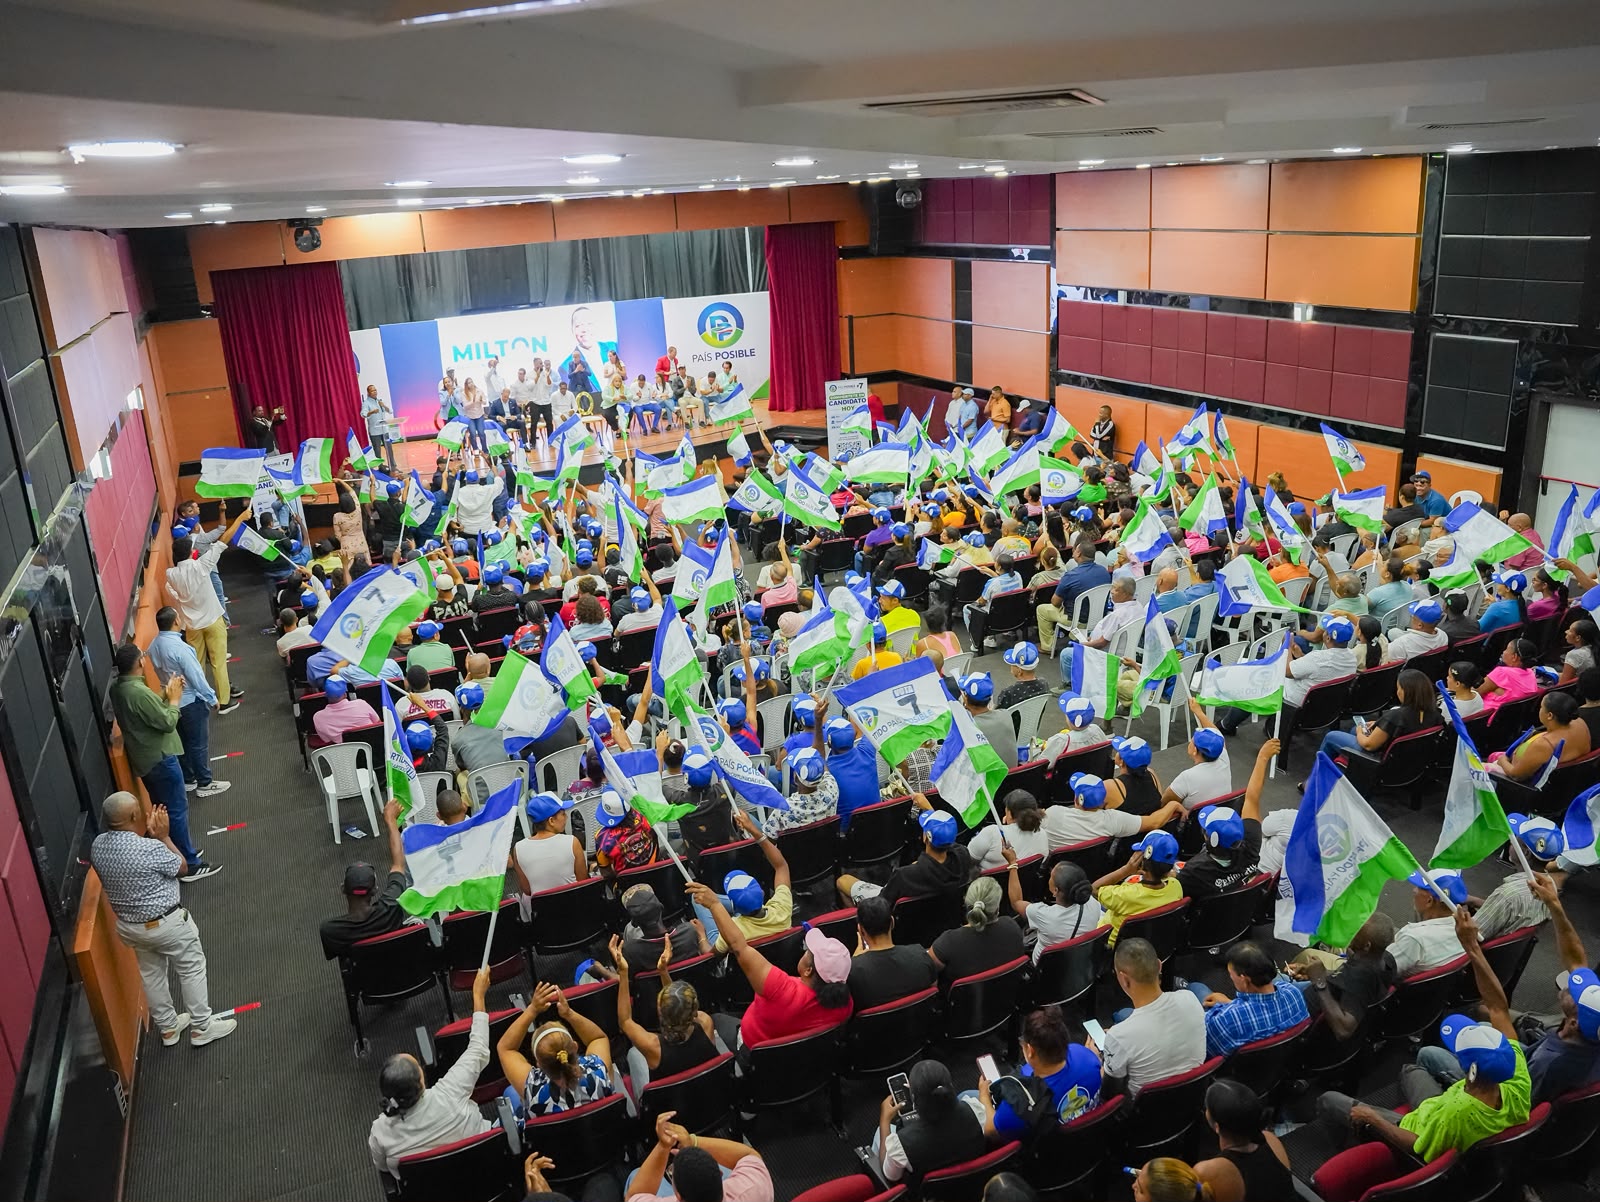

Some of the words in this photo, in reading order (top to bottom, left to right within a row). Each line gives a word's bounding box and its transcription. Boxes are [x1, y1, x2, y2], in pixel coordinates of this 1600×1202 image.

[714, 348, 756, 360] POSIBLE
[828, 398, 867, 407] CANDIDATO
[433, 599, 469, 620] PAIN
[408, 699, 447, 714] GASTER
[897, 694, 921, 716] 7
[719, 757, 735, 770] PAÍS
